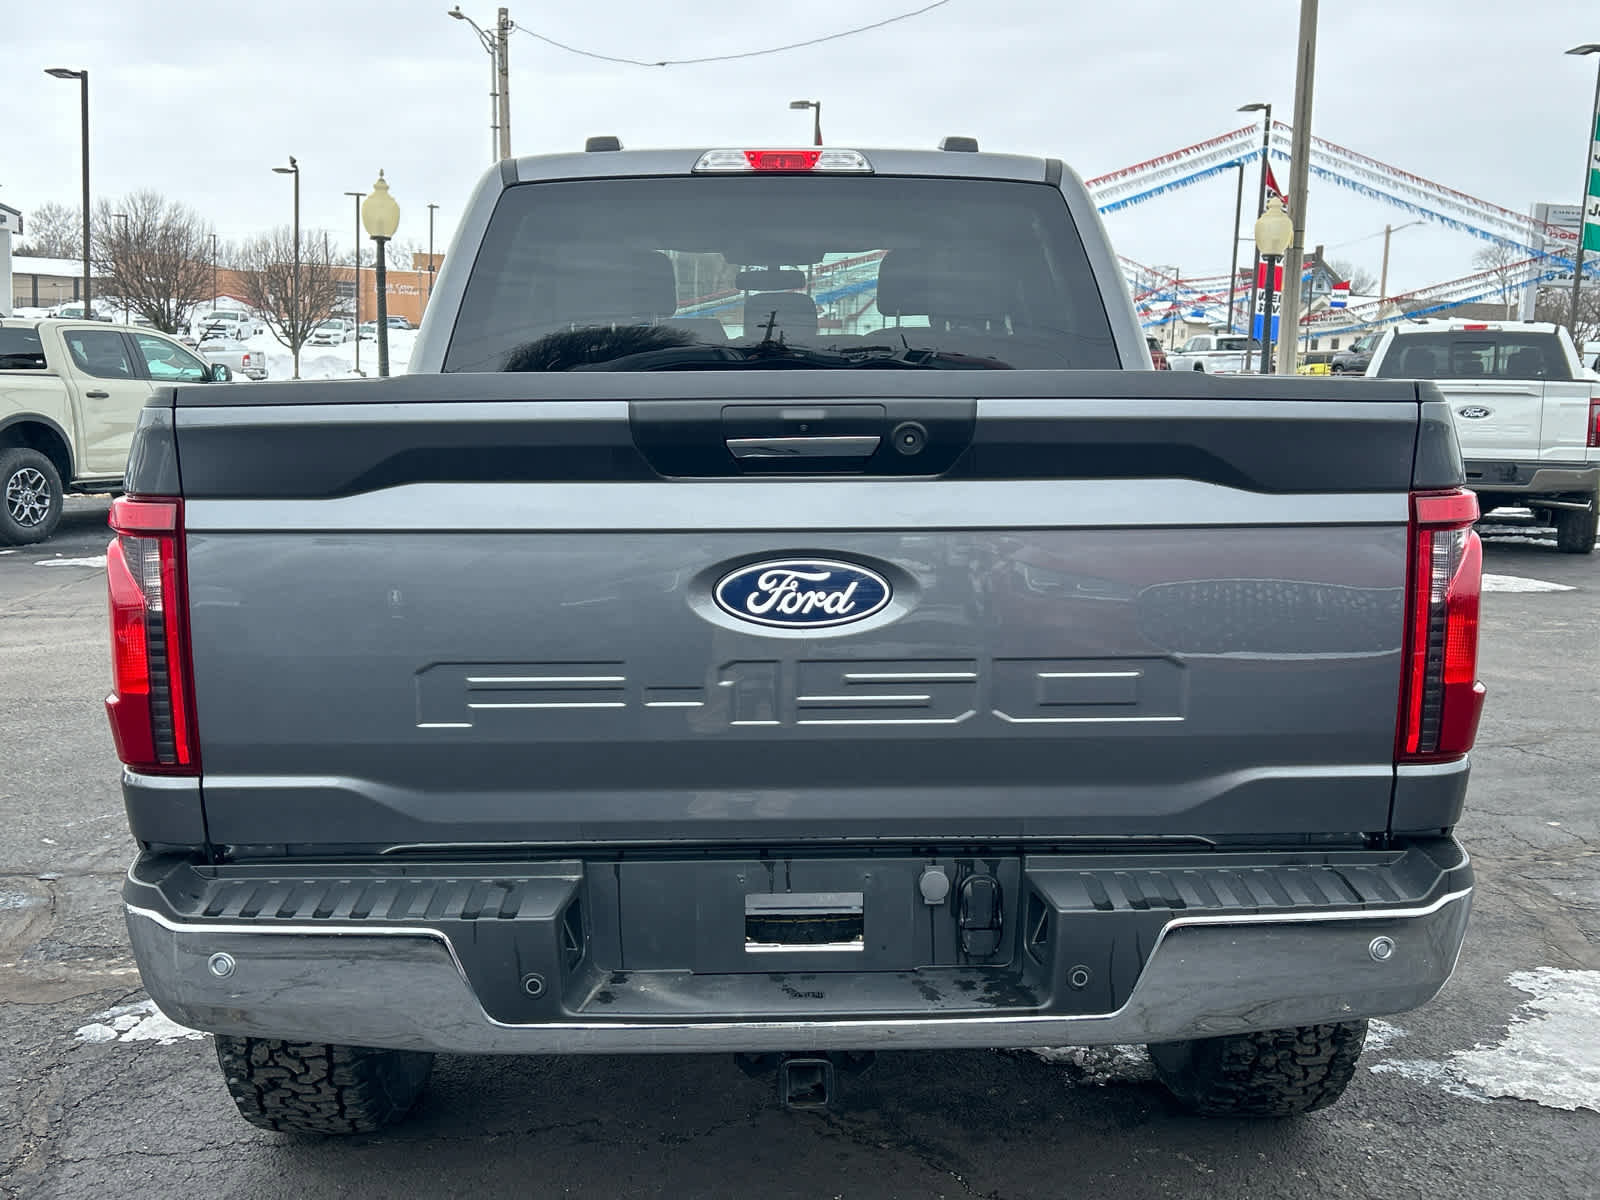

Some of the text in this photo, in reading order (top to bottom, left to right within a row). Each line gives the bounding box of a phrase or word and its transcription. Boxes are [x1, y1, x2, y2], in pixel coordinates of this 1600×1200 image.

[1463, 408, 1486, 417] Ford
[746, 569, 859, 615] Ford
[415, 655, 1187, 728] F-150
